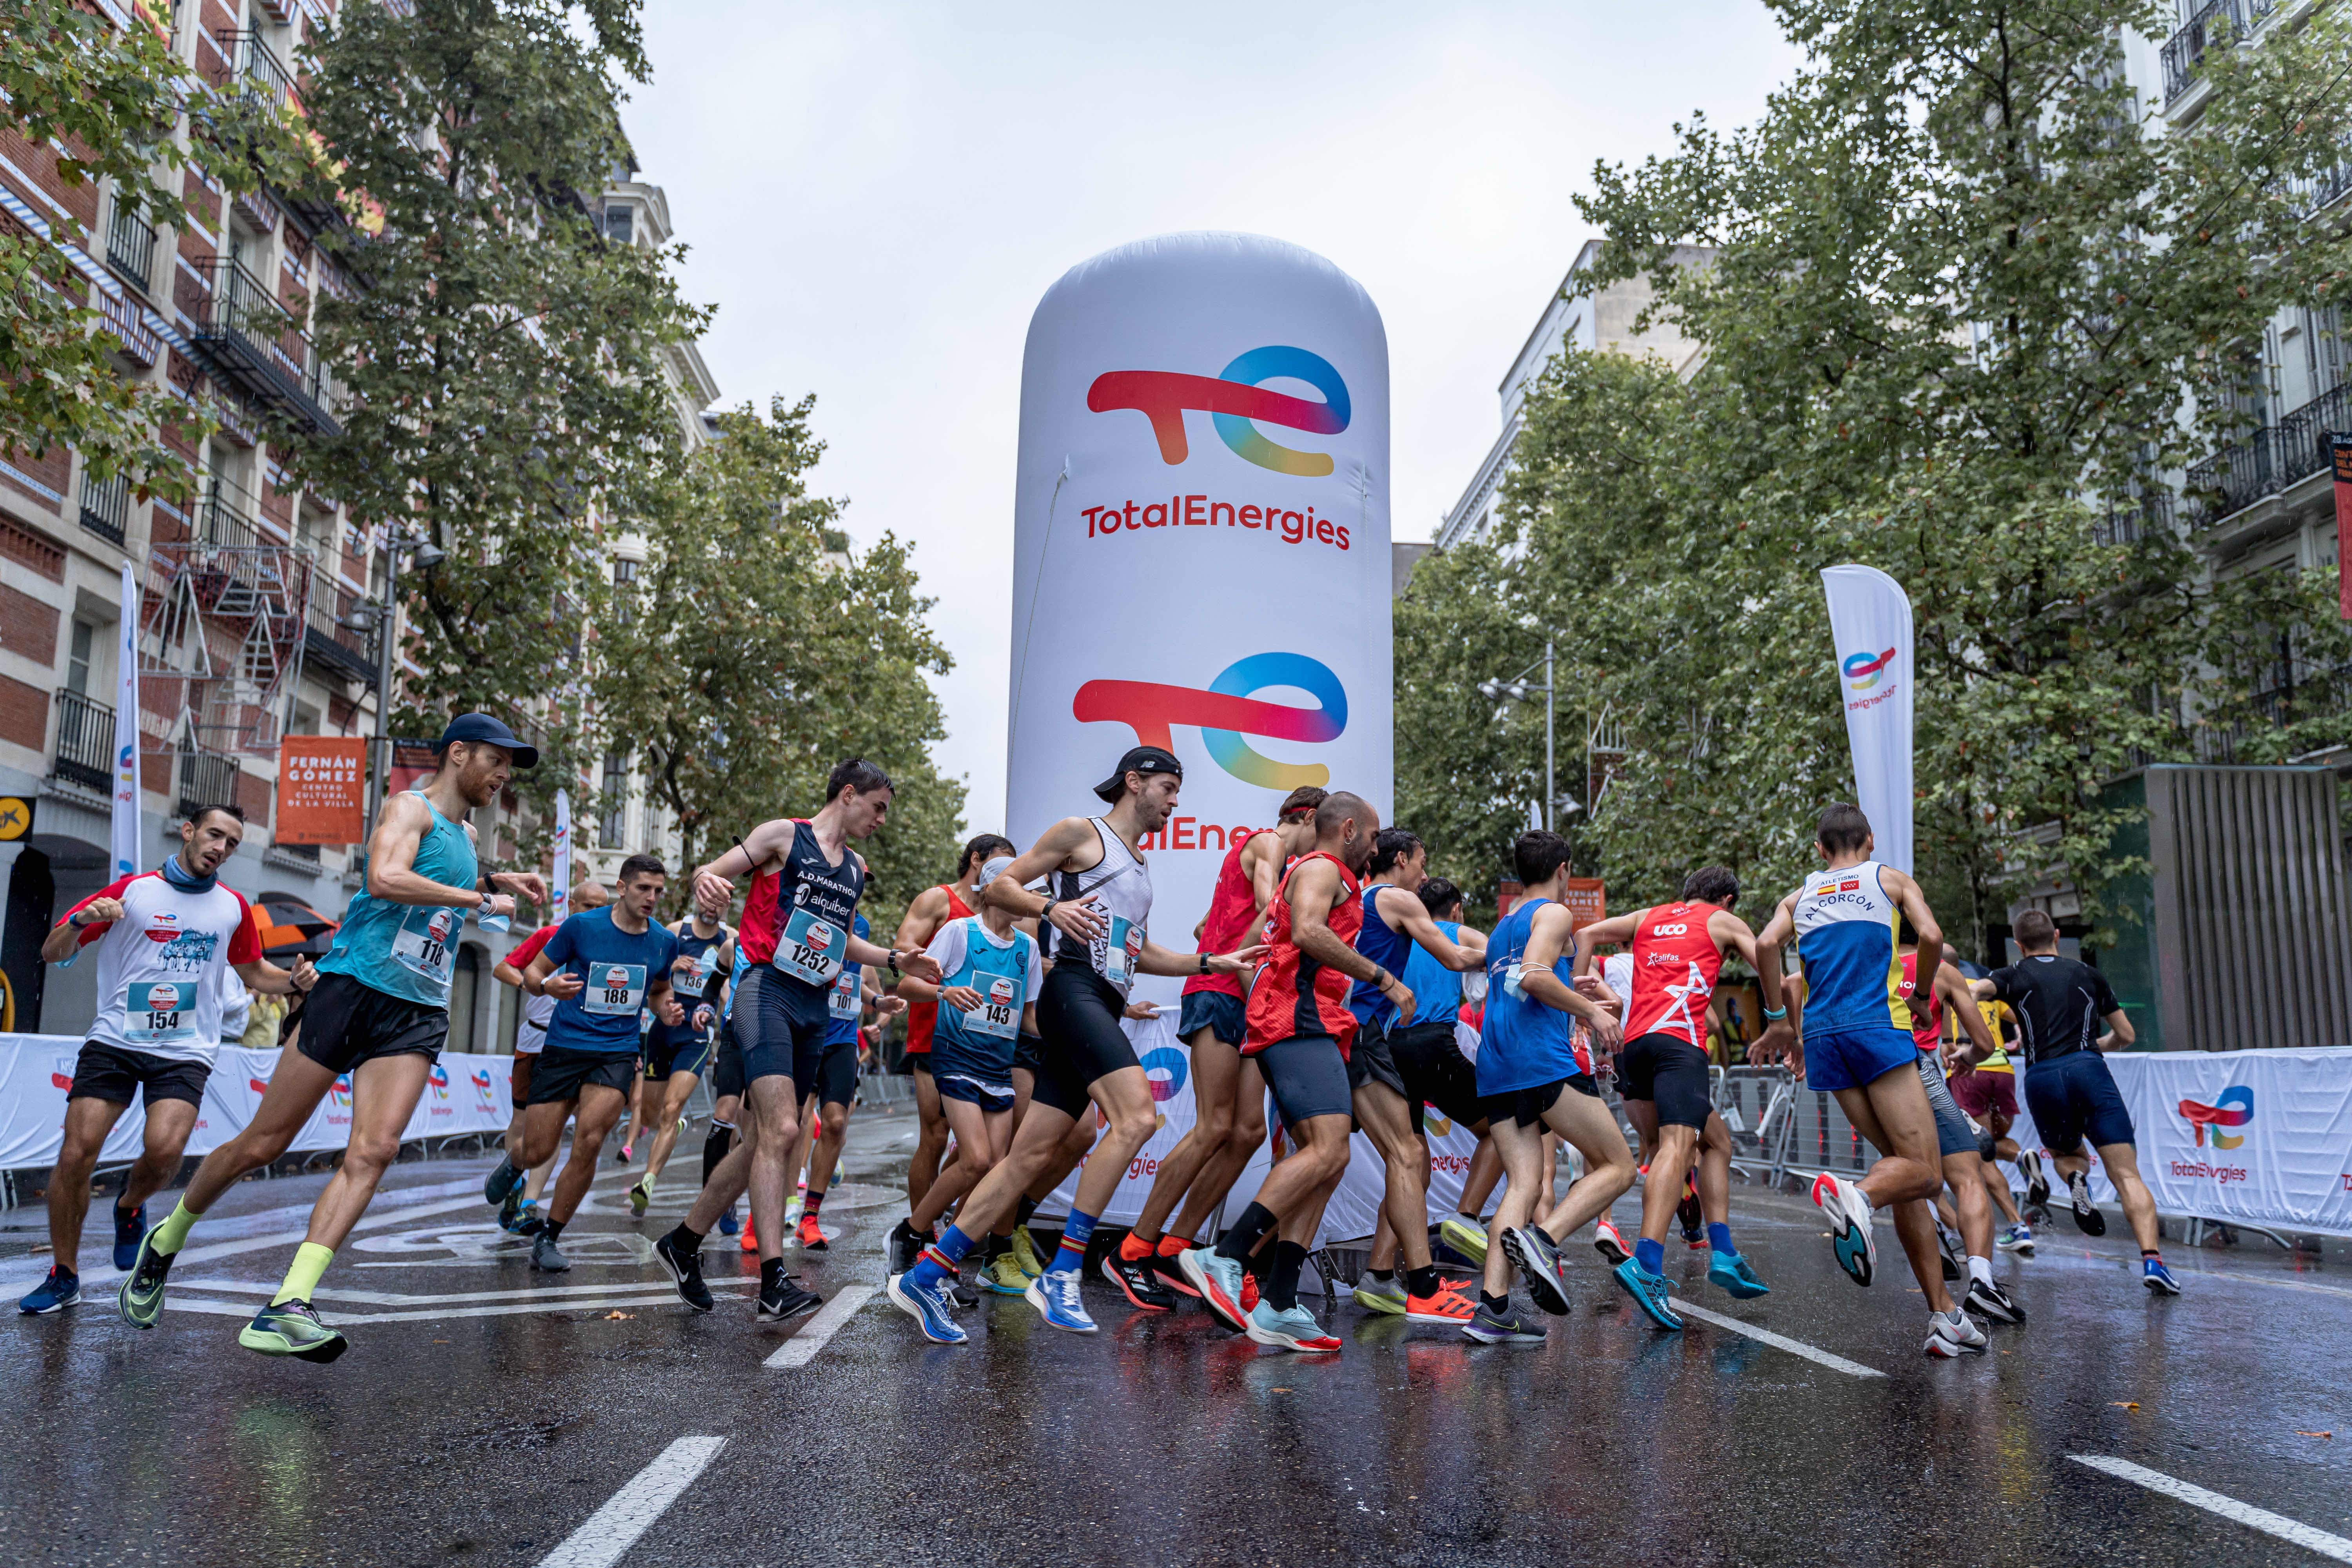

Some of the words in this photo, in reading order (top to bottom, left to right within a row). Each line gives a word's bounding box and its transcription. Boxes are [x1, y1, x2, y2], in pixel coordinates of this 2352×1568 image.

[1081, 495, 1350, 550] TotalEnergies
[290, 754, 356, 769] FERNÁN
[289, 766, 356, 782] GÓMEZ
[295, 791, 348, 799] CULTURAL
[797, 871, 857, 899] A.D.MARATHON
[1820, 874, 1859, 886] ATLETISMO
[810, 891, 850, 916] alquiber
[1806, 894, 1875, 921] ALCORCÓN
[1653, 924, 1688, 936] UCO
[421, 940, 444, 966] 118
[791, 944, 829, 976] 1252
[684, 975, 702, 989] 136
[603, 989, 629, 1004] 188
[837, 995, 851, 1010] 101
[146, 1011, 179, 1029] 154
[986, 1004, 1010, 1025] 143
